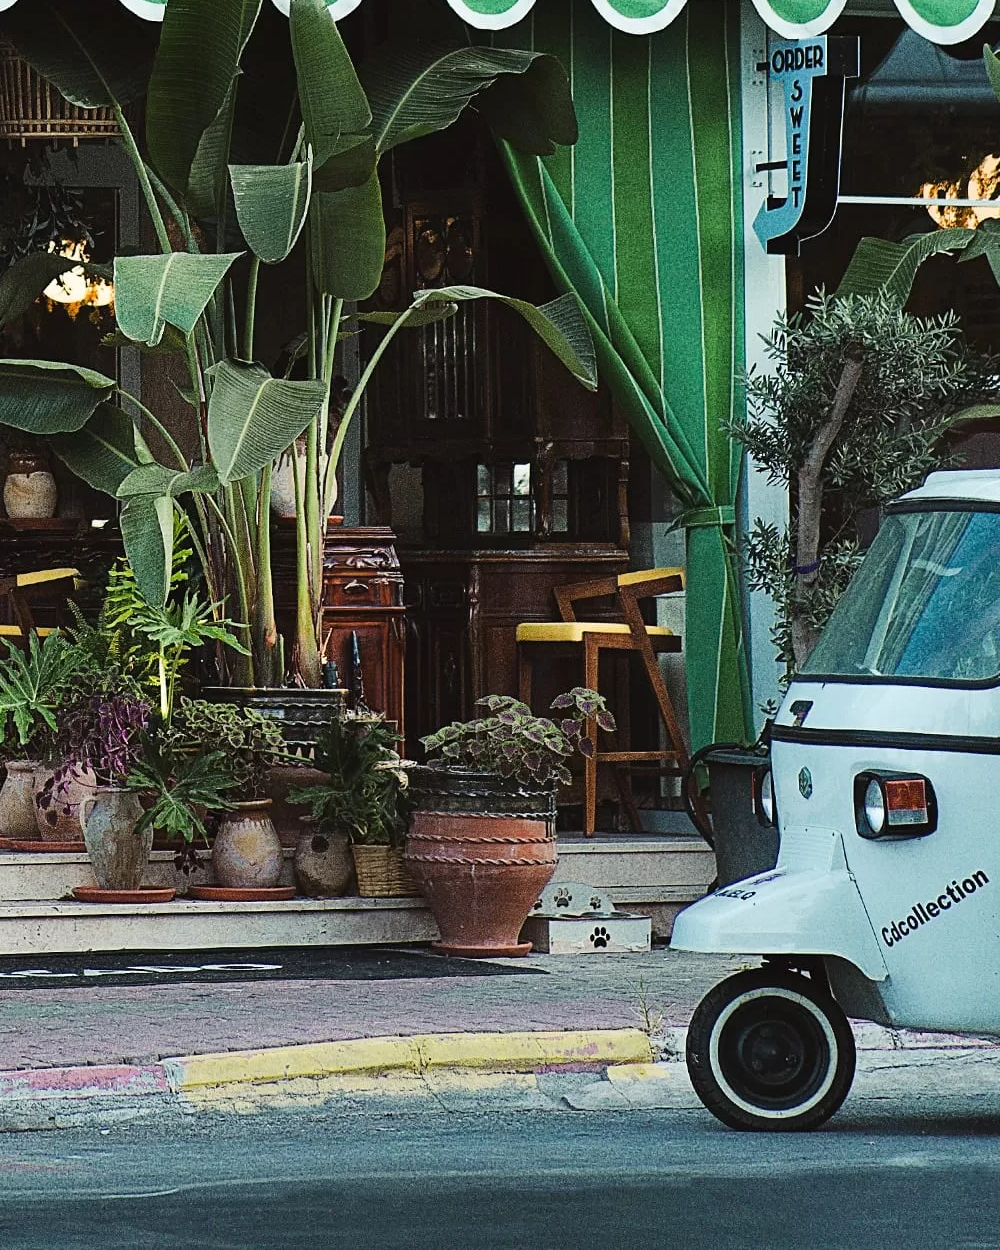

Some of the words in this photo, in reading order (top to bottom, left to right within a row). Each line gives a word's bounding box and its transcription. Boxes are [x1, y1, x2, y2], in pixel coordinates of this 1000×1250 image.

[772, 45, 823, 73] ORDER
[790, 79, 803, 208] SWEET
[881, 870, 990, 948] Cdcollection
